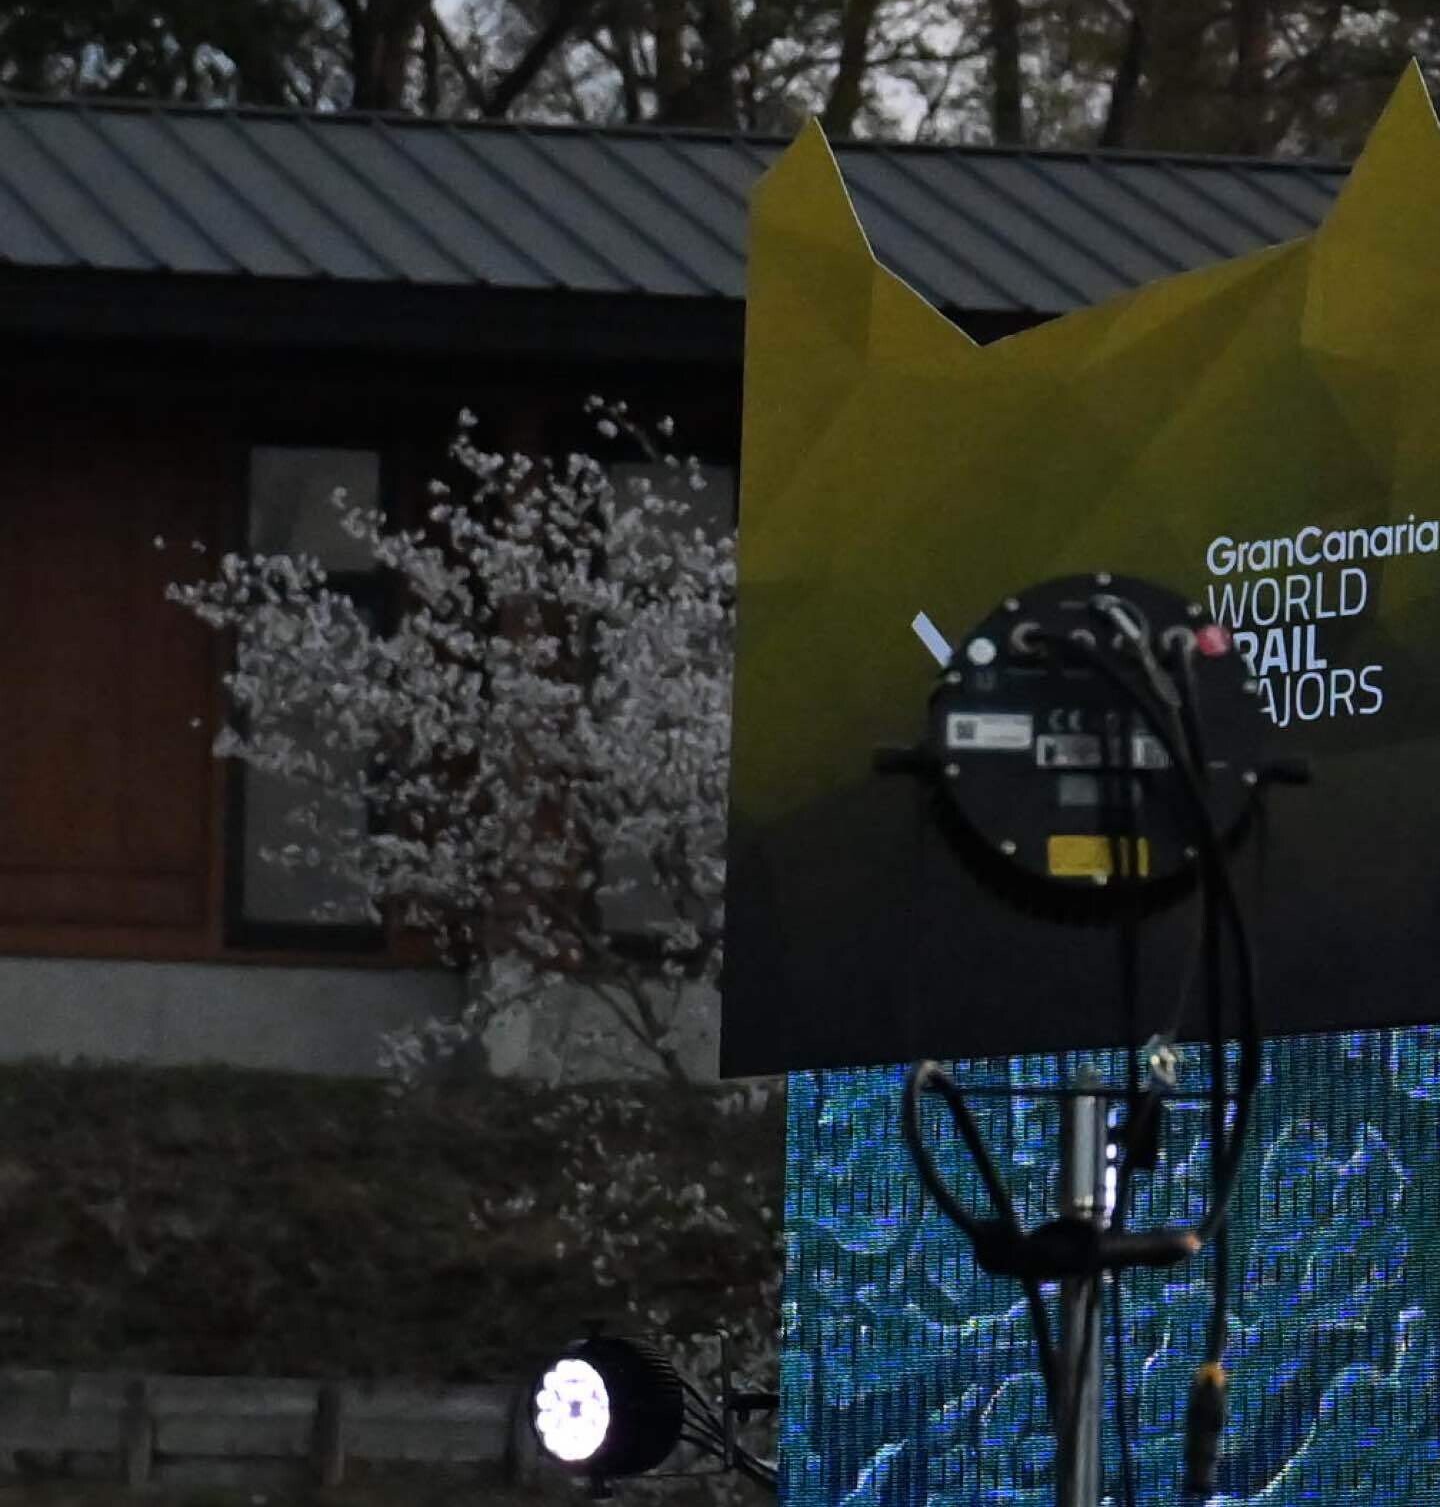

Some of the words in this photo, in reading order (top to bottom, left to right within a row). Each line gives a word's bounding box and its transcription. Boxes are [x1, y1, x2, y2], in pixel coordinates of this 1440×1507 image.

[1206, 514, 1440, 576] GranCanaria
[1208, 568, 1367, 629] WORLD
[1232, 624, 1328, 677] RAIL
[1256, 665, 1384, 728] AJORS
